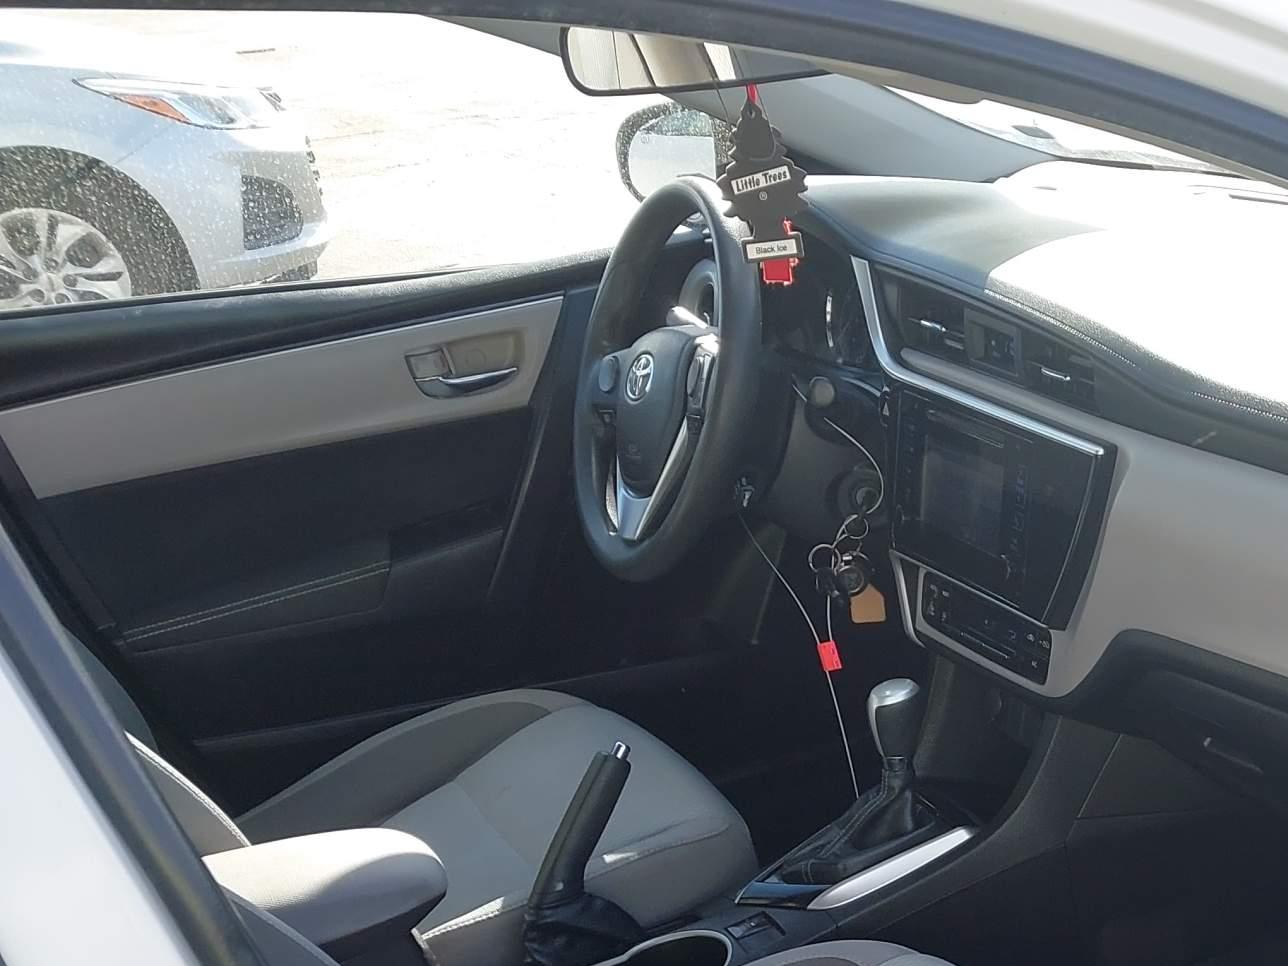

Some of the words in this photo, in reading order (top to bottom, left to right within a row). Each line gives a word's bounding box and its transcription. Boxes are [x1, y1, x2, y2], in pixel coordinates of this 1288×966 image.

[735, 175, 760, 193] Little
[762, 170, 787, 185] Trees
[755, 246, 775, 255] Black
